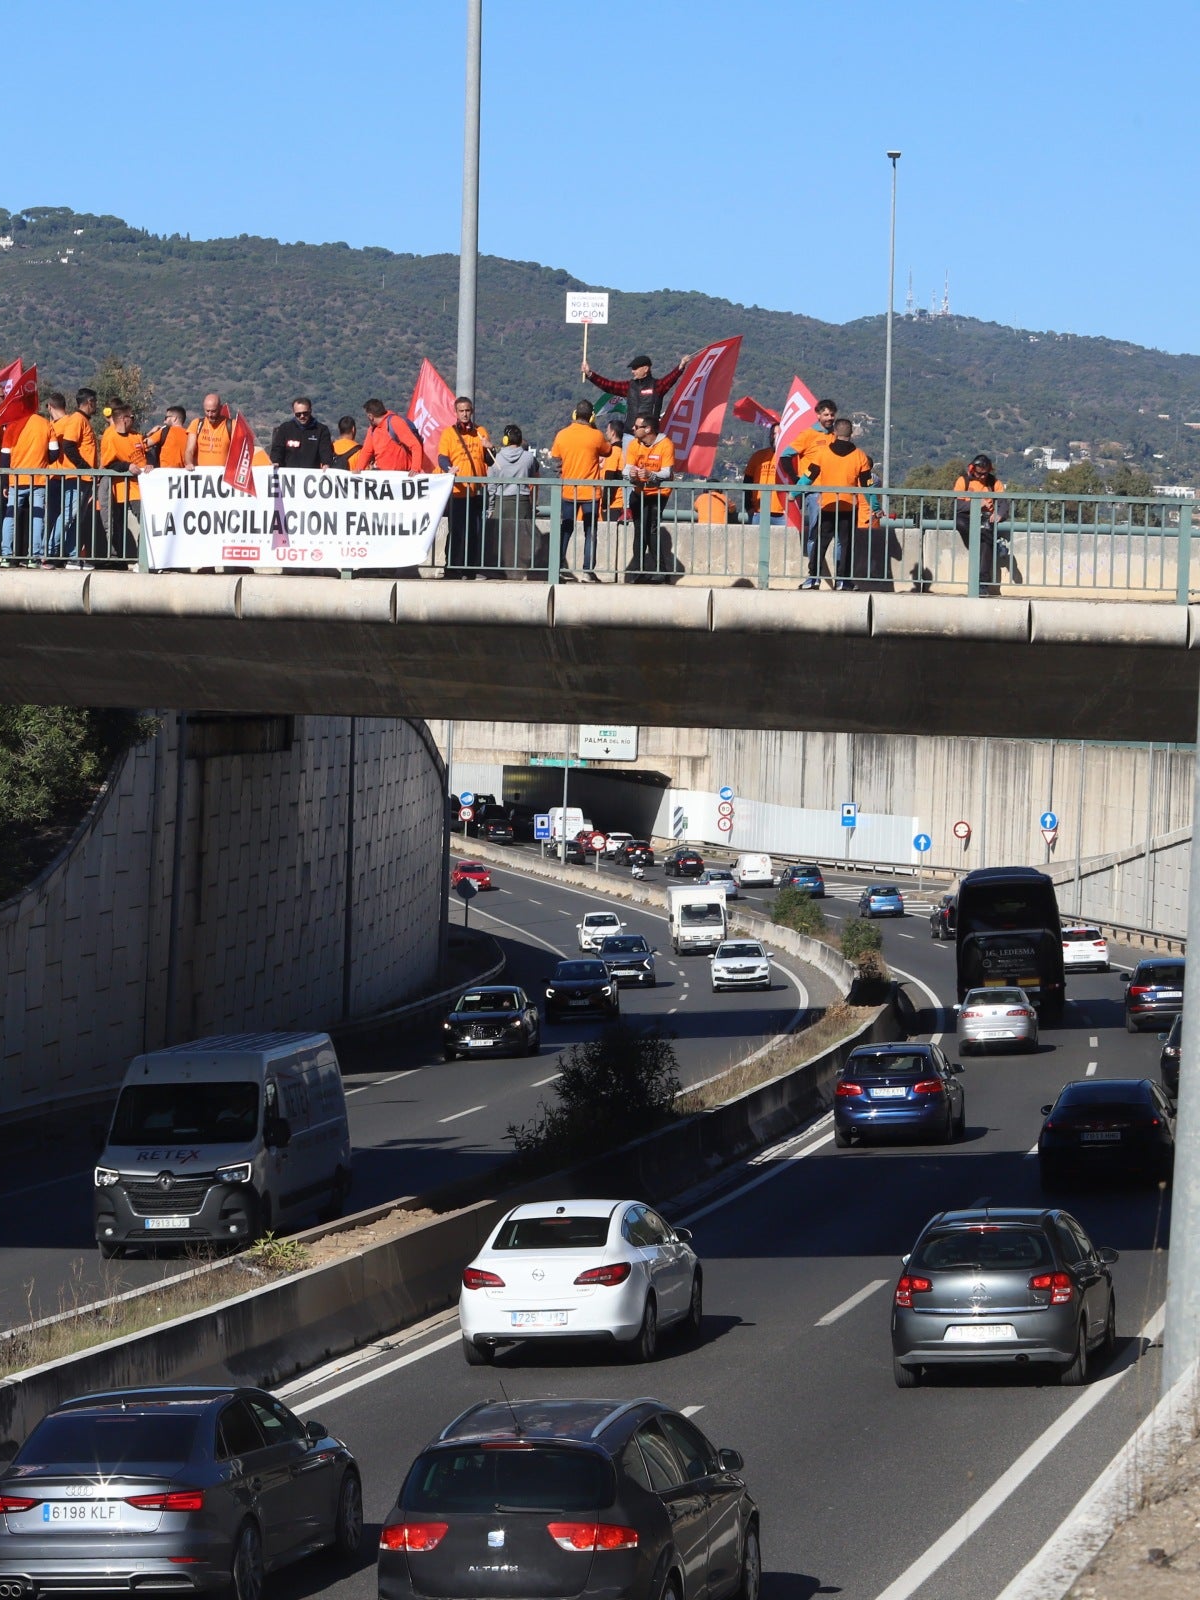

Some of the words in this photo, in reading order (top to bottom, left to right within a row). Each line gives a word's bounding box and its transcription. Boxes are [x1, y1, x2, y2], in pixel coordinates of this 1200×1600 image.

[571, 309, 605, 318] OPCIÓN
[268, 474, 296, 499] EN
[303, 474, 395, 501] CONTRA
[402, 477, 430, 501] DE
[152, 511, 177, 537] LA
[183, 510, 338, 536] CONCILIACION
[223, 549, 260, 558] CCOO
[276, 549, 308, 561] UGT
[340, 547, 368, 558] USO
[137, 1150, 201, 1164] RETEX
[150, 1219, 171, 1228] 7913
[51, 1505, 86, 1519] 6198
[90, 1506, 116, 1519] KLF
